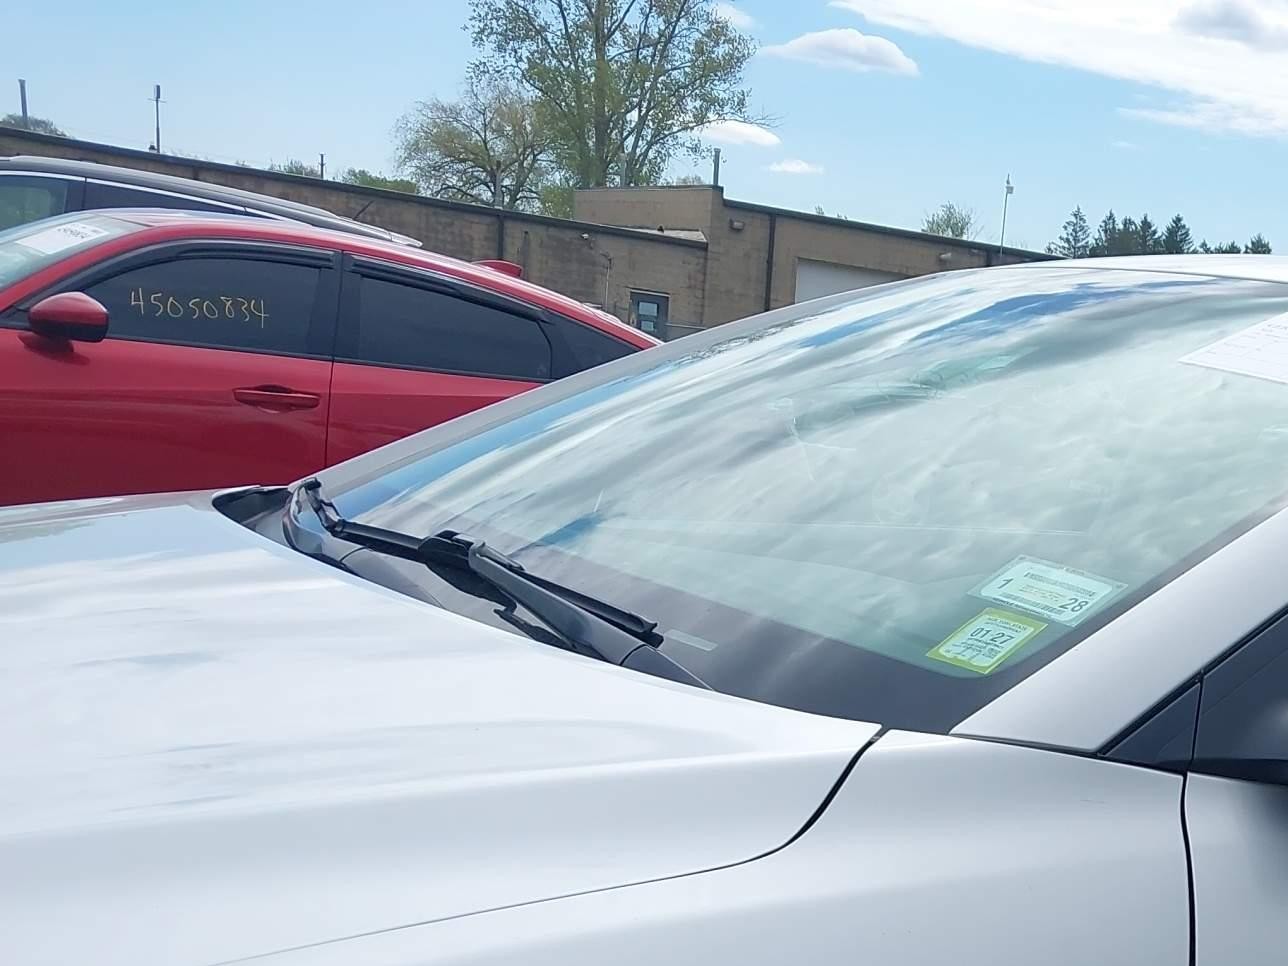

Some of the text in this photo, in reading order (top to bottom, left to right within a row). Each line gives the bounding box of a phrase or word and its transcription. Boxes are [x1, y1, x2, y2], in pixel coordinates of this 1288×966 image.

[131, 288, 269, 328] 45050834
[997, 578, 1014, 589] 1
[1059, 597, 1089, 613] 28
[970, 627, 992, 639] 01
[989, 632, 1016, 645] 27
